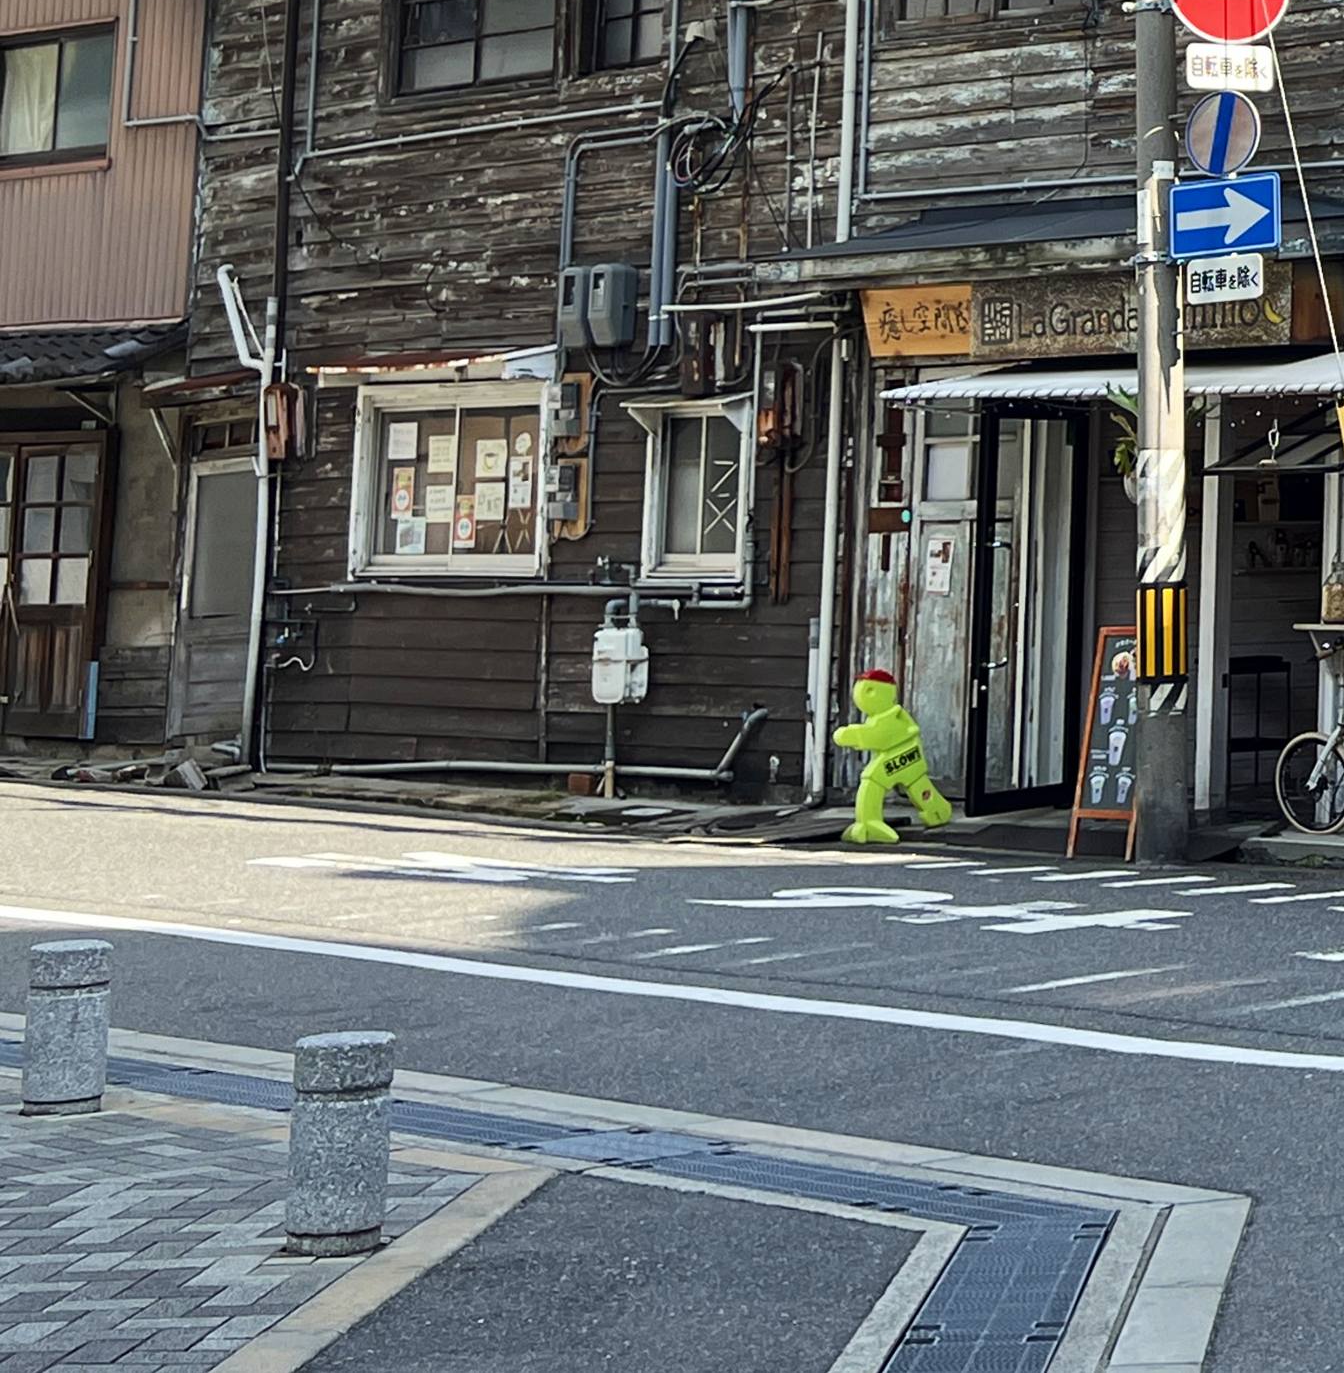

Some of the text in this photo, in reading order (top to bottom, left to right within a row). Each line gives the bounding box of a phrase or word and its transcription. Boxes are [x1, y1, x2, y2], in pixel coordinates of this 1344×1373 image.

[1191, 54, 1268, 79] 自転車を除く
[1190, 265, 1259, 294] 自転車を除く
